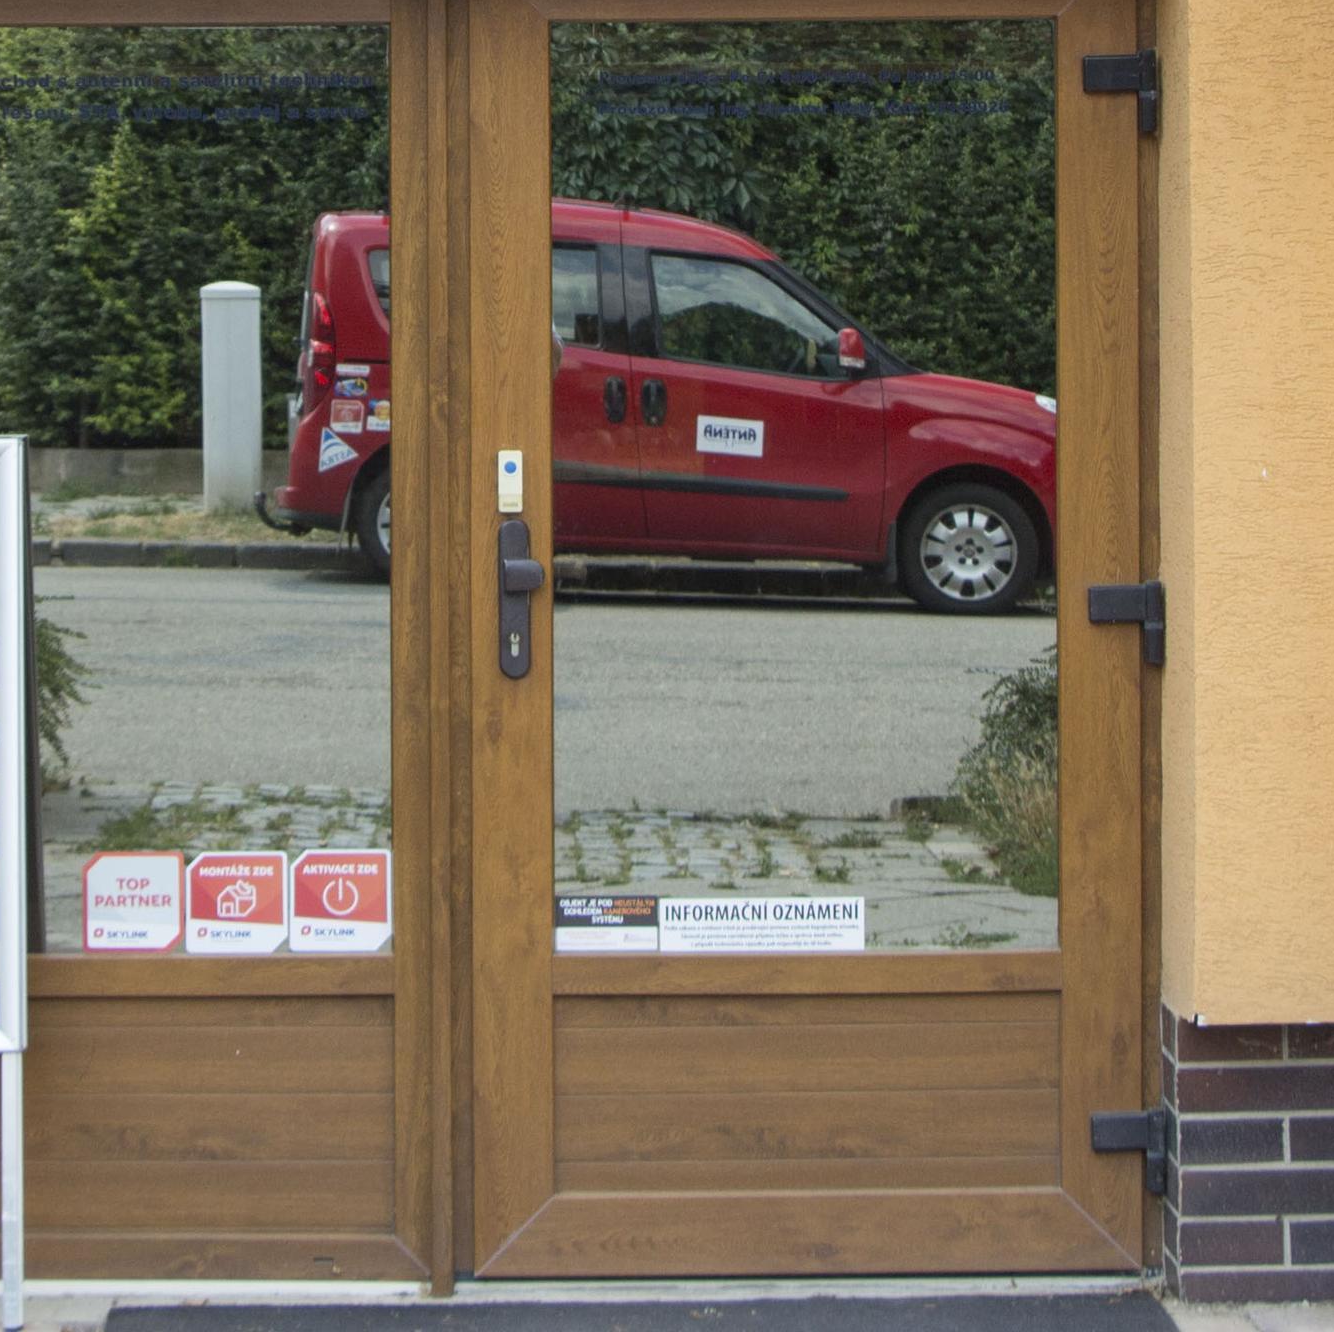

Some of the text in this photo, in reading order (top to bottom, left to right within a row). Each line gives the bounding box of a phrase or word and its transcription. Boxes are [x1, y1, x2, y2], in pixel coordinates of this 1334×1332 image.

[199, 863, 274, 877] MONTÁŽE ZDE
[302, 863, 379, 875] AKTIVACE ZDE
[117, 878, 150, 891] TOP
[94, 894, 172, 908] PARTNER
[665, 899, 859, 922] INFORMAČNÍ OZNÁMENÍ
[107, 930, 149, 939] SKYLINK
[210, 930, 252, 938] SKYLINK
[314, 927, 355, 936] SKYLINK
